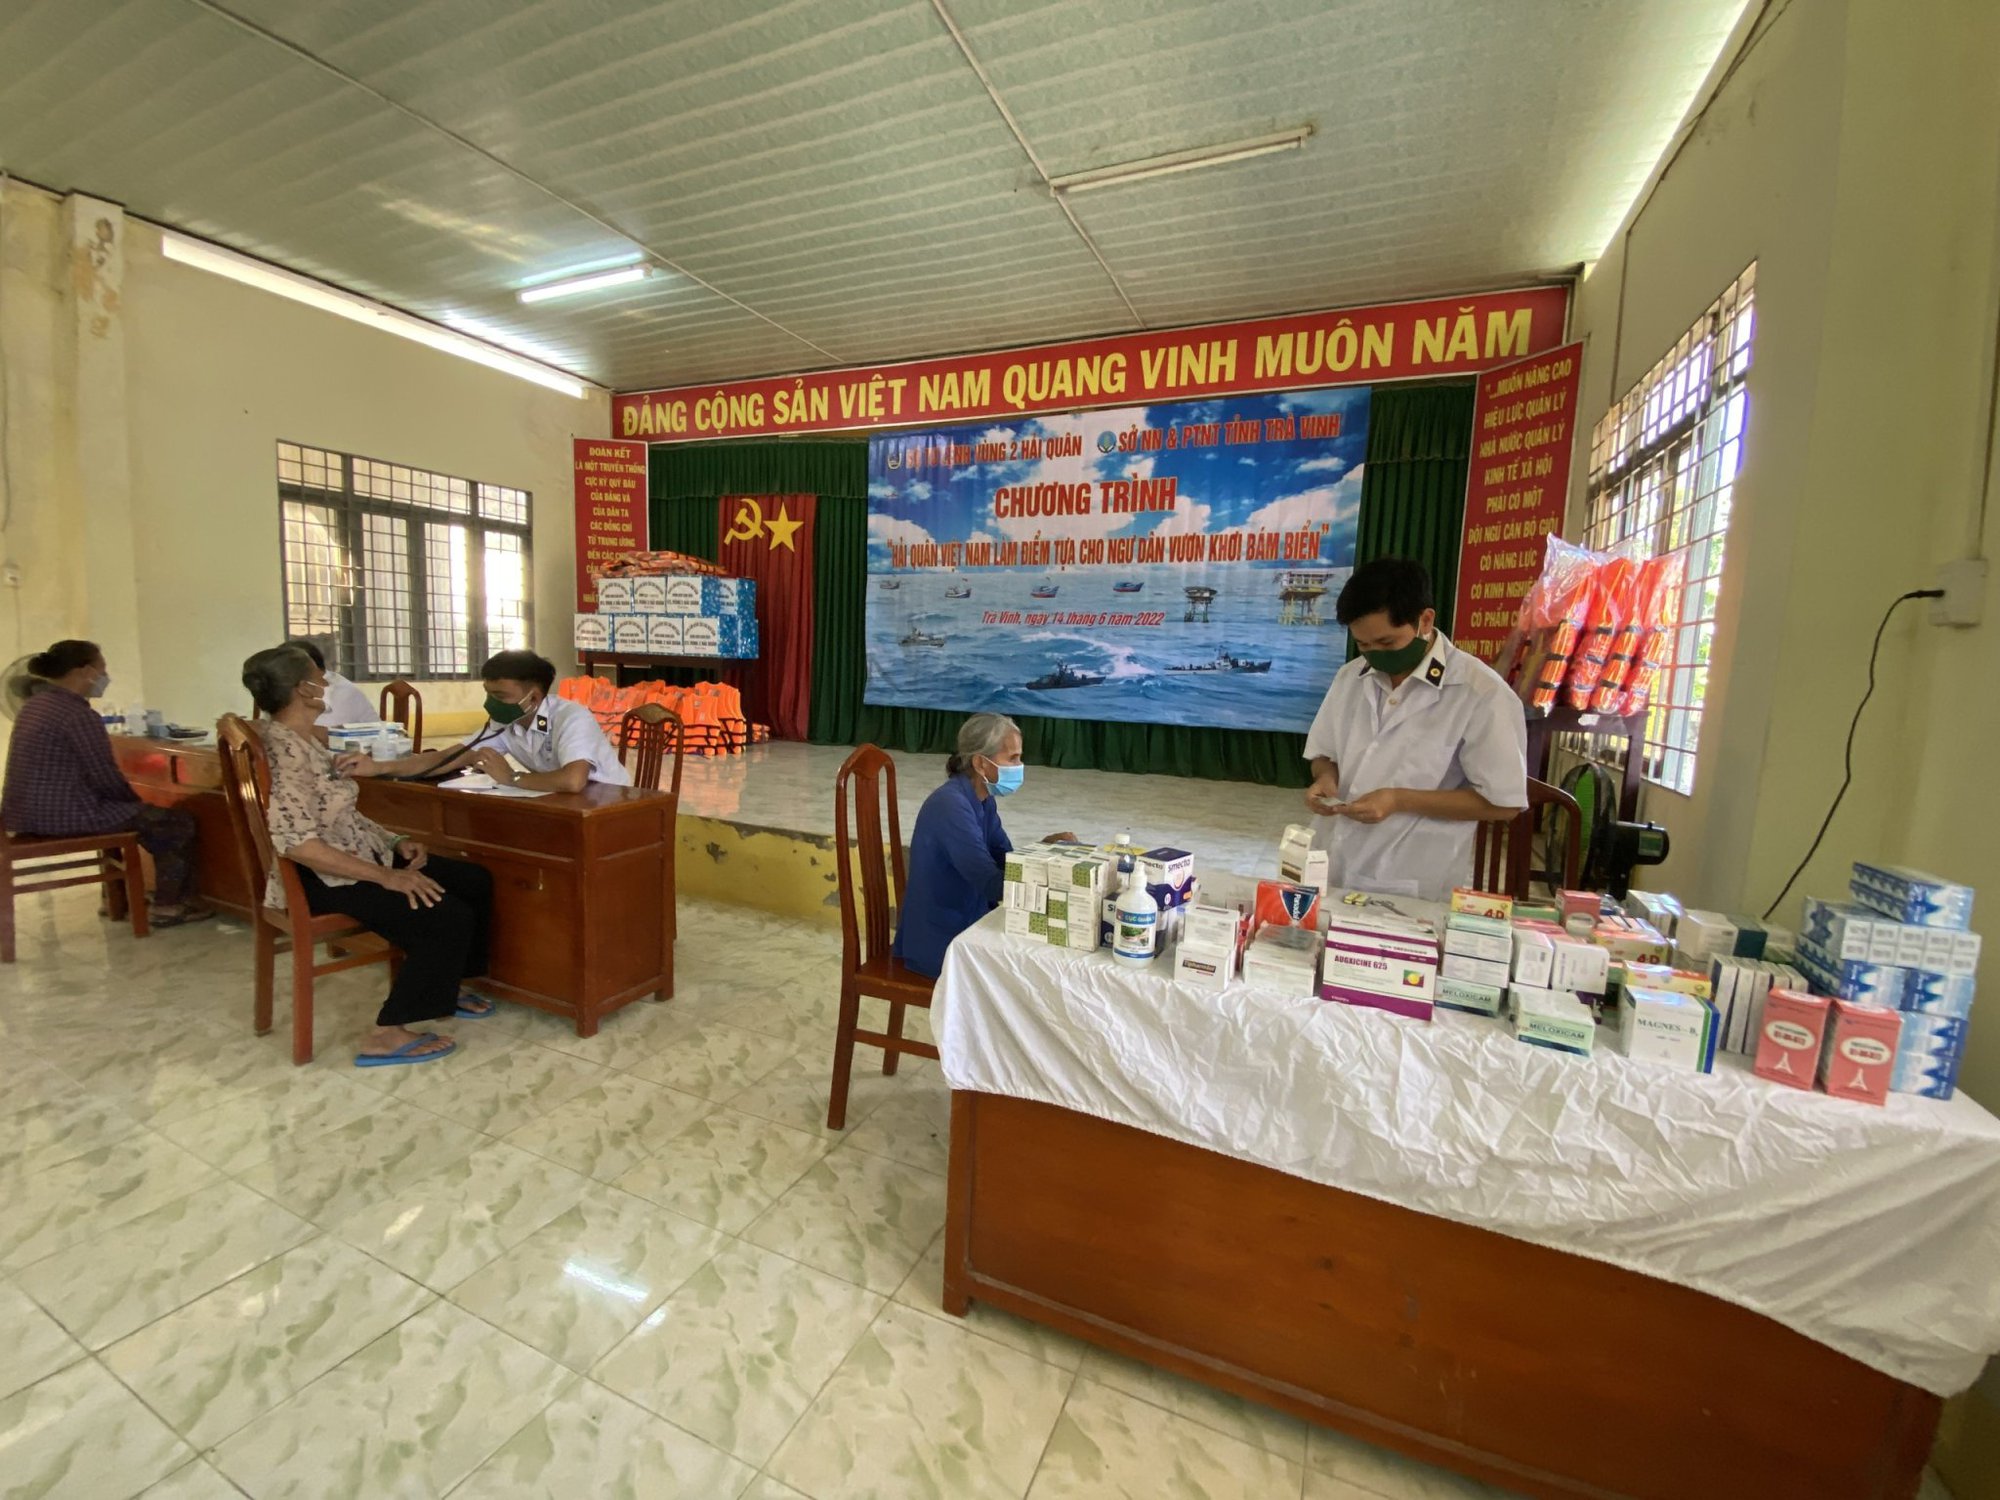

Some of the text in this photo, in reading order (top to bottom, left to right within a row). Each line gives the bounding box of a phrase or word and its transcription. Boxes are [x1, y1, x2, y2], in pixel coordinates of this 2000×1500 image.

[623, 306, 1533, 436] ĐẢNG CỘNG SẢN VIỆT NAM QUANG VINH MUÔN NĂM
[1524, 365, 1551, 389] NÂNG
[1552, 358, 1572, 380] CAO
[1506, 401, 1524, 424] LỰC
[1526, 390, 1552, 420] QUẢN
[1553, 386, 1567, 411] LÝ
[1118, 412, 1342, 453] SỞ NN & PTNT TỈNH TRÀ VINH
[1524, 422, 1549, 450] QUẢN
[1551, 418, 1566, 442] LÝ
[614, 445, 631, 459] KẾT
[974, 438, 1006, 464] VÙNG
[1010, 440, 1017, 461] 2
[1021, 433, 1042, 461] HẢI
[1046, 432, 1082, 458] QUÂN
[1484, 453, 1553, 486] KINH TẾ XÃ HỘI
[994, 472, 1178, 519] CHƯƠNG TRÌNH
[1486, 485, 1544, 514] PHẢI CÓ MỘT
[620, 508, 630, 518] TA
[1468, 523, 1483, 548] ĐỘI
[1484, 521, 1501, 543] NGŨ
[1503, 518, 1522, 541] CÁN
[1523, 516, 1537, 540] BỘ
[910, 538, 938, 570] QUÂN
[941, 537, 963, 572] VIỆT
[965, 542, 991, 566] NAM
[994, 534, 1017, 566] LÀM
[1021, 529, 1050, 566] ĐIỂM
[1054, 536, 1075, 570] TỰA
[1079, 538, 1104, 565] CHO
[1107, 534, 1136, 565] NGƯ
[1137, 531, 1165, 564] DÂN
[1169, 532, 1205, 563] VƯƠN
[1208, 530, 1241, 562] KHƠI
[1246, 527, 1280, 561] BÁM
[1480, 548, 1538, 571] CÓ NĂNG LỰC
[1471, 577, 1537, 599] CÓ KINH NGHIỆ
[1052, 611, 1065, 625] 14
[1099, 612, 1107, 624] 6
[1134, 612, 1165, 626] 2022
[1471, 607, 1483, 627] CÓ
[1484, 603, 1510, 627] PHẨM
[1480, 637, 1494, 659] TRỊ
[1168, 859, 1190, 872] smecta
[1373, 961, 1388, 971] 625
[1442, 988, 1492, 1002] MELOXICAM
[1529, 1022, 1585, 1040] MELOXICAM
[1638, 1018, 1681, 1031] MAGNES
